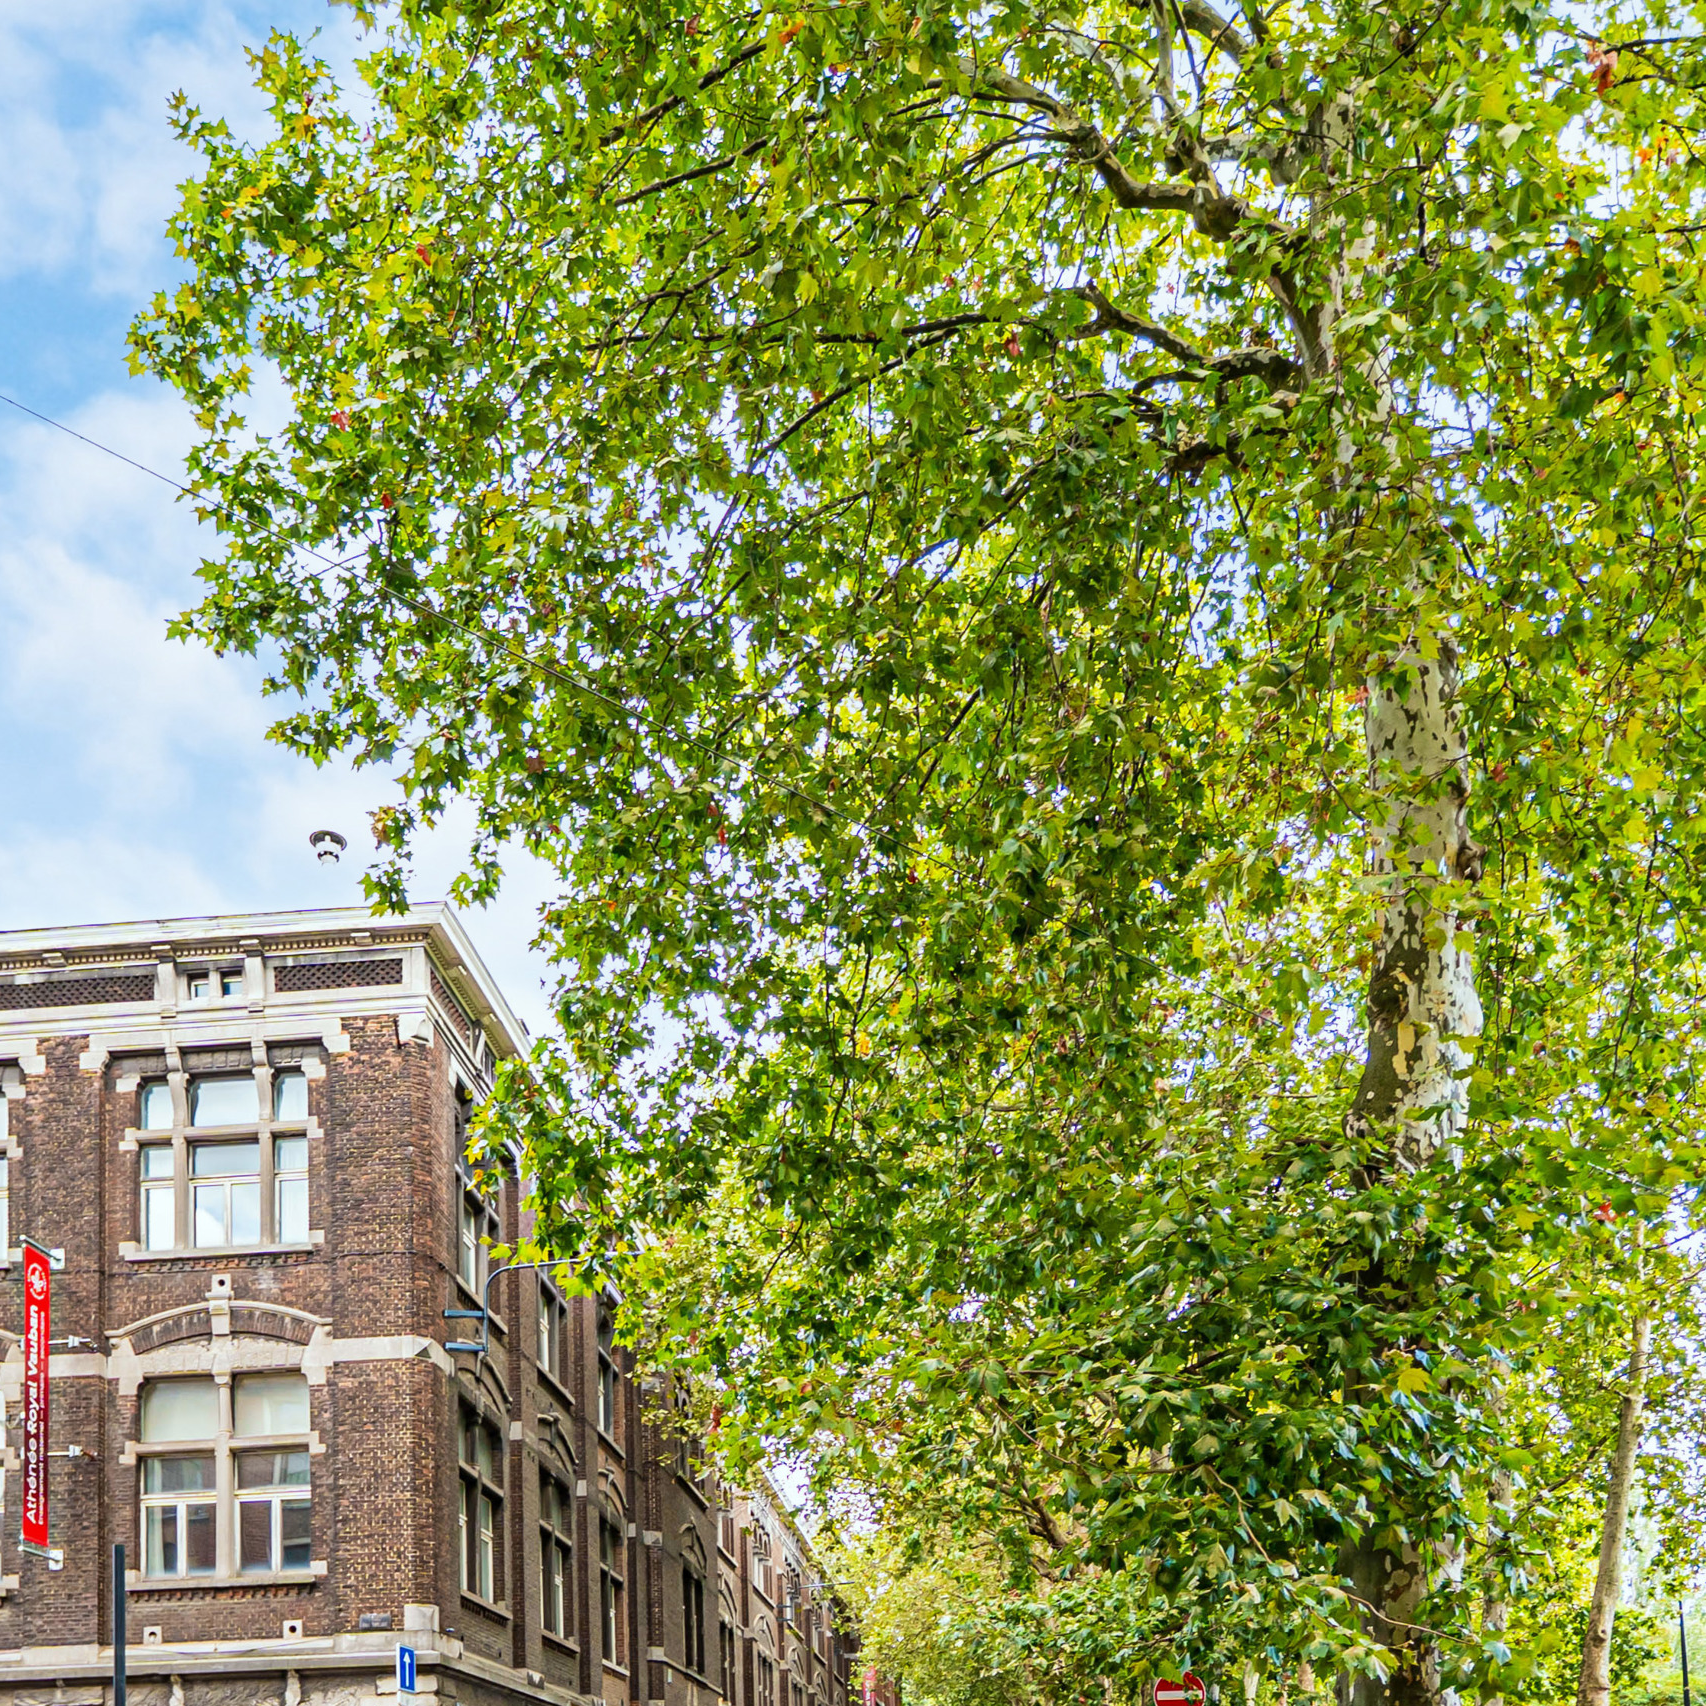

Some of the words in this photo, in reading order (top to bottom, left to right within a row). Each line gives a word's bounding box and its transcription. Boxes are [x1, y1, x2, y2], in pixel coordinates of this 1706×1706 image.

[27, 1304, 38, 1376] Vauban
[27, 1381, 39, 1434] Royal
[26, 1438, 37, 1524] Athénée
